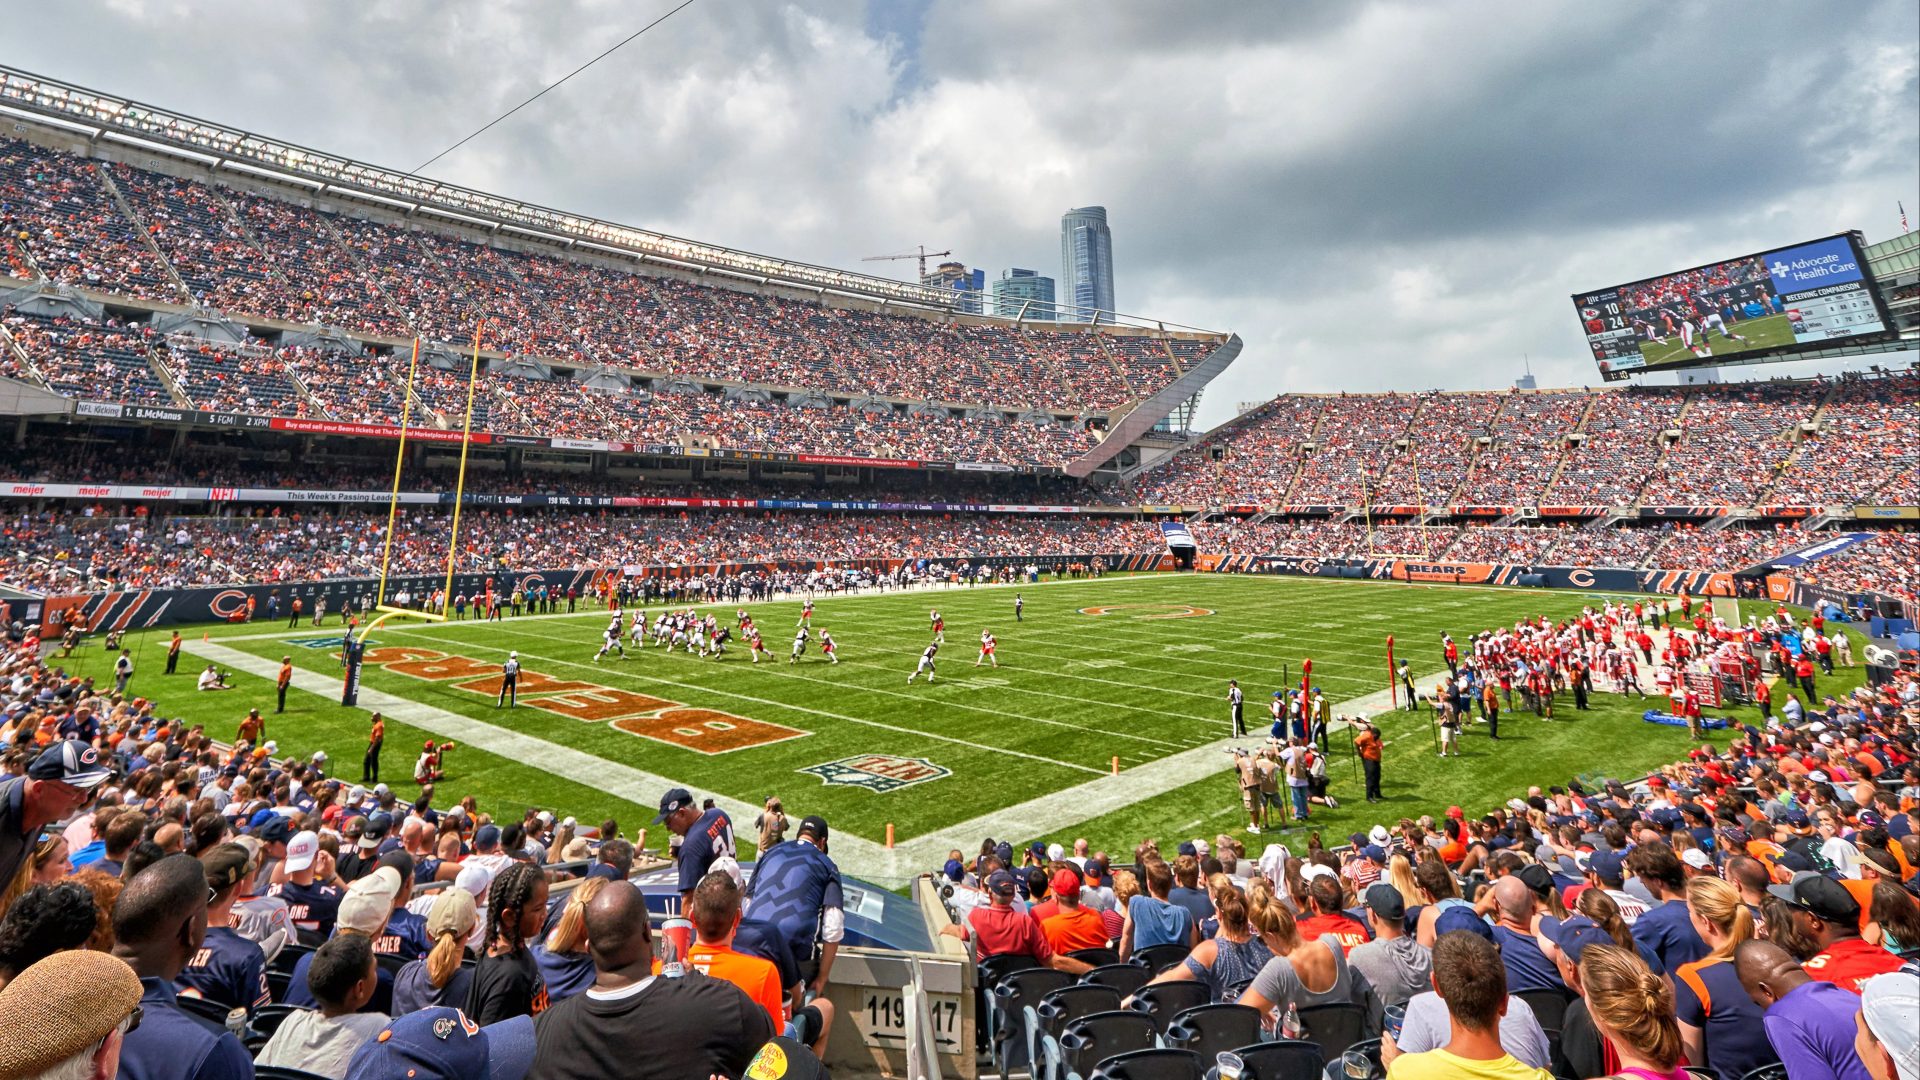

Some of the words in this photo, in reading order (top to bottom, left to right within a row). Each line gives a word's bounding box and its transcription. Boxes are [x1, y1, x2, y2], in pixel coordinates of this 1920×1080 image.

[1791, 254, 1840, 270] Advocate
[1793, 266, 1829, 281] Health
[1829, 262, 1856, 274] Care
[1786, 290, 1818, 302] RECEIVING
[1818, 282, 1860, 296] COMPARISON
[1605, 302, 1619, 315] 10
[1609, 316, 1624, 329] 24
[78, 404, 92, 413] NFL
[94, 406, 120, 417] Kicking
[126, 408, 132, 416] 1.
[136, 408, 182, 420] B.McManus
[209, 415, 215, 423] 5
[217, 416, 233, 424] FGM
[246, 418, 252, 426] 2
[253, 418, 268, 427] XPM
[286, 421, 297, 429] Buy
[355, 426, 374, 434] tickets
[414, 430, 447, 439] Marketplace
[454, 432, 462, 440] the
[670, 447, 679, 455] 24
[13, 484, 45, 496] meijer
[79, 486, 110, 498] meijer
[143, 487, 171, 498] meijer
[211, 488, 236, 500] NFL
[287, 492, 304, 500] This
[307, 492, 336, 500] Week's
[338, 493, 369, 502] Passing
[372, 494, 402, 502] Leades
[478, 495, 492, 503] CHI
[505, 496, 522, 504] Daniel
[1873, 509, 1900, 517] Snapple
[1408, 564, 1466, 574] BEARS
[1772, 584, 1785, 593] GSH
[49, 610, 63, 625] GS
[331, 646, 815, 756] BEARS
[851, 756, 938, 781] NFL
[287, 904, 309, 919] ONG
[868, 995, 905, 1028] 119
[932, 1001, 957, 1032] 17
[764, 1044, 783, 1060] Bass
[760, 1054, 775, 1065] Pro
[756, 1063, 779, 1080] Shops
